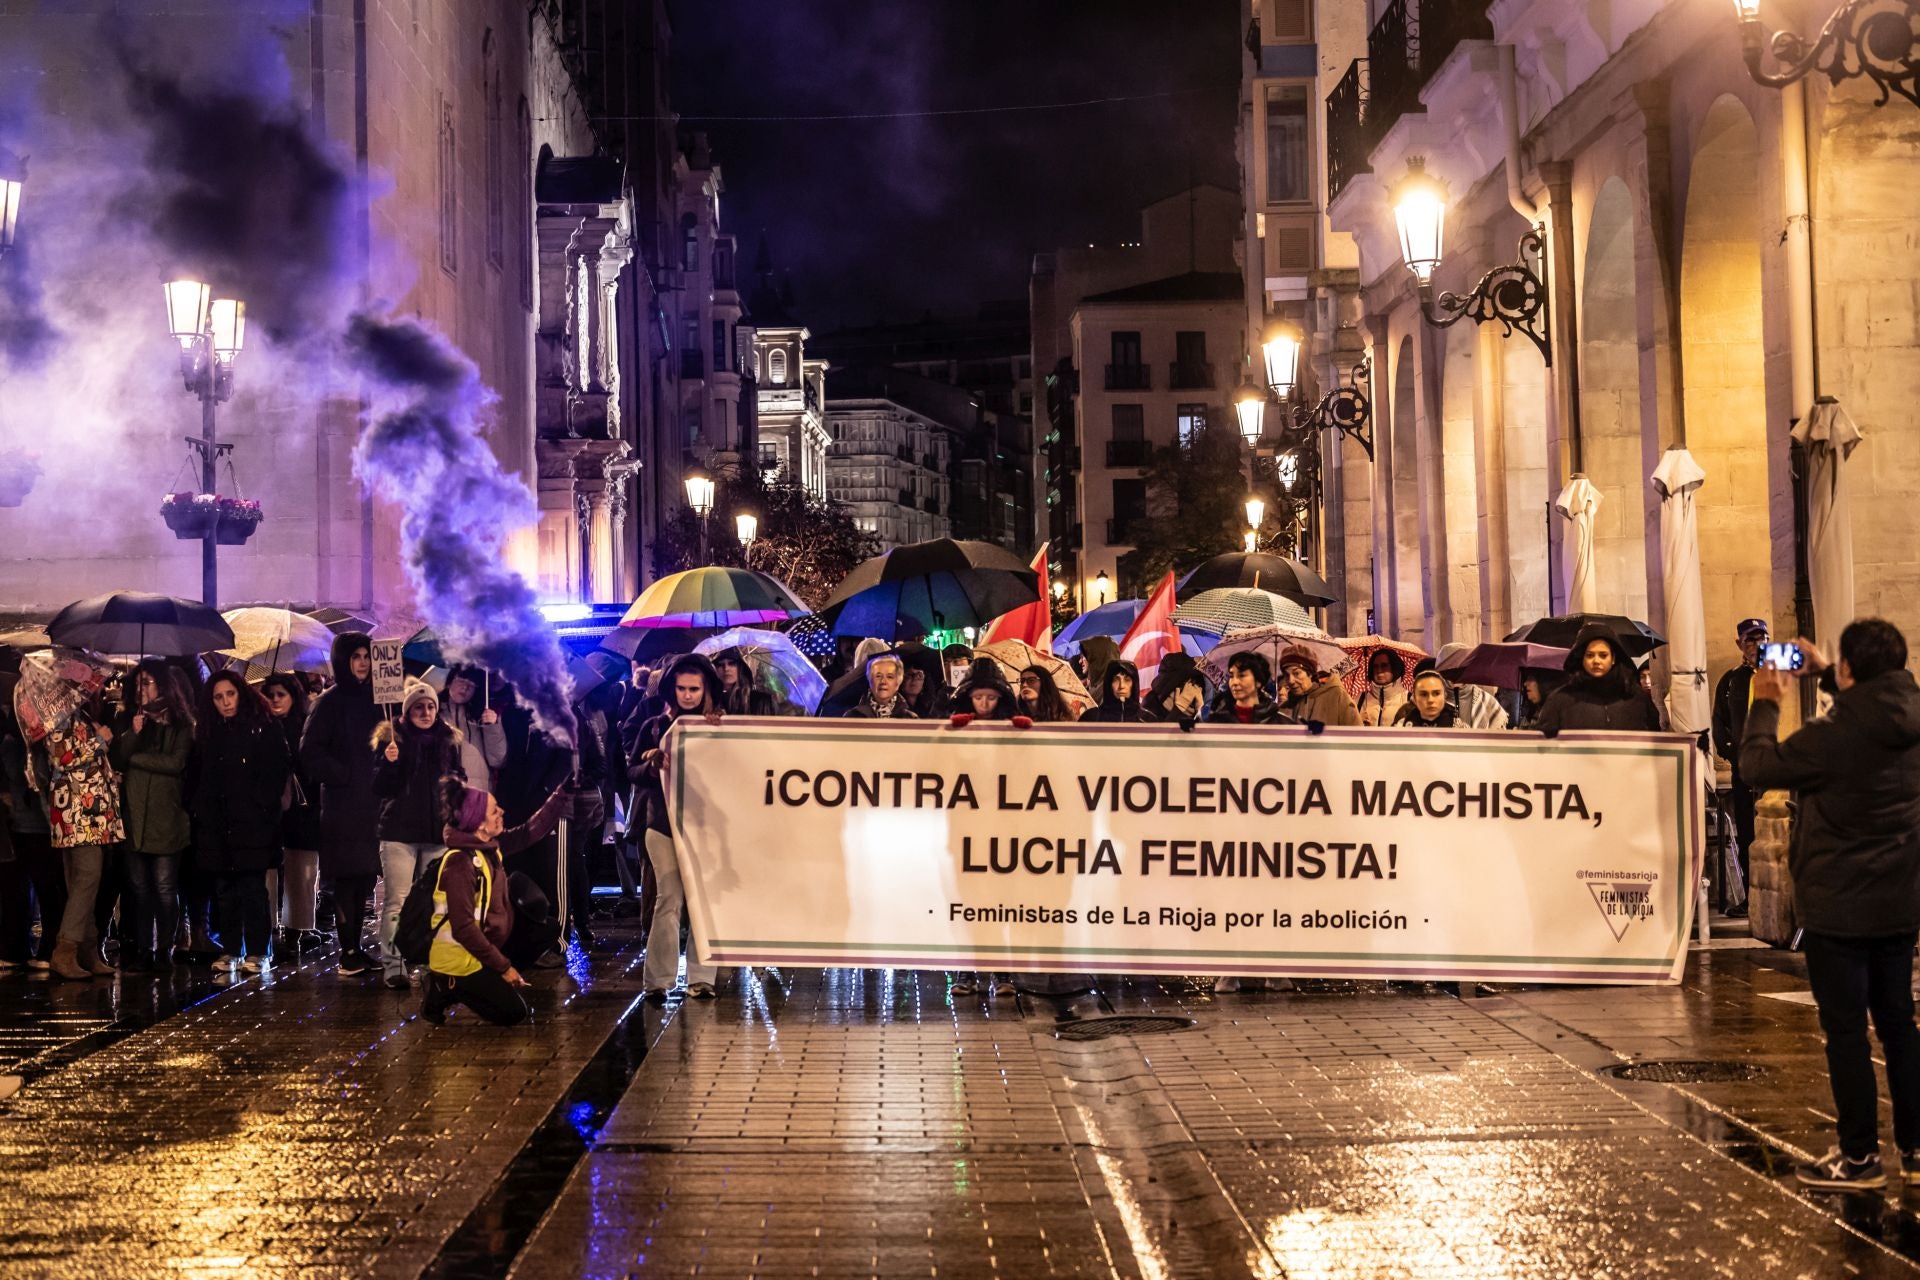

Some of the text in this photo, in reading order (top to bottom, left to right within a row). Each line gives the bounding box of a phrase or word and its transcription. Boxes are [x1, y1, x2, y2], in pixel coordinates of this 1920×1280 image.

[372, 645, 398, 661] ONLY
[379, 662, 401, 678] FANS
[764, 769, 1603, 829] ¡CONTRA LA VIOLENCIA MACHISTA,
[961, 836, 1398, 880] LUCHA FEMINISTA!
[1576, 870, 1658, 881] @feministasrioja
[1600, 891, 1649, 903] FEMINISTAS
[949, 902, 1408, 933] Feministas de La Rioja por la abolición
[1607, 904, 1654, 918] DE LA RIOJA
